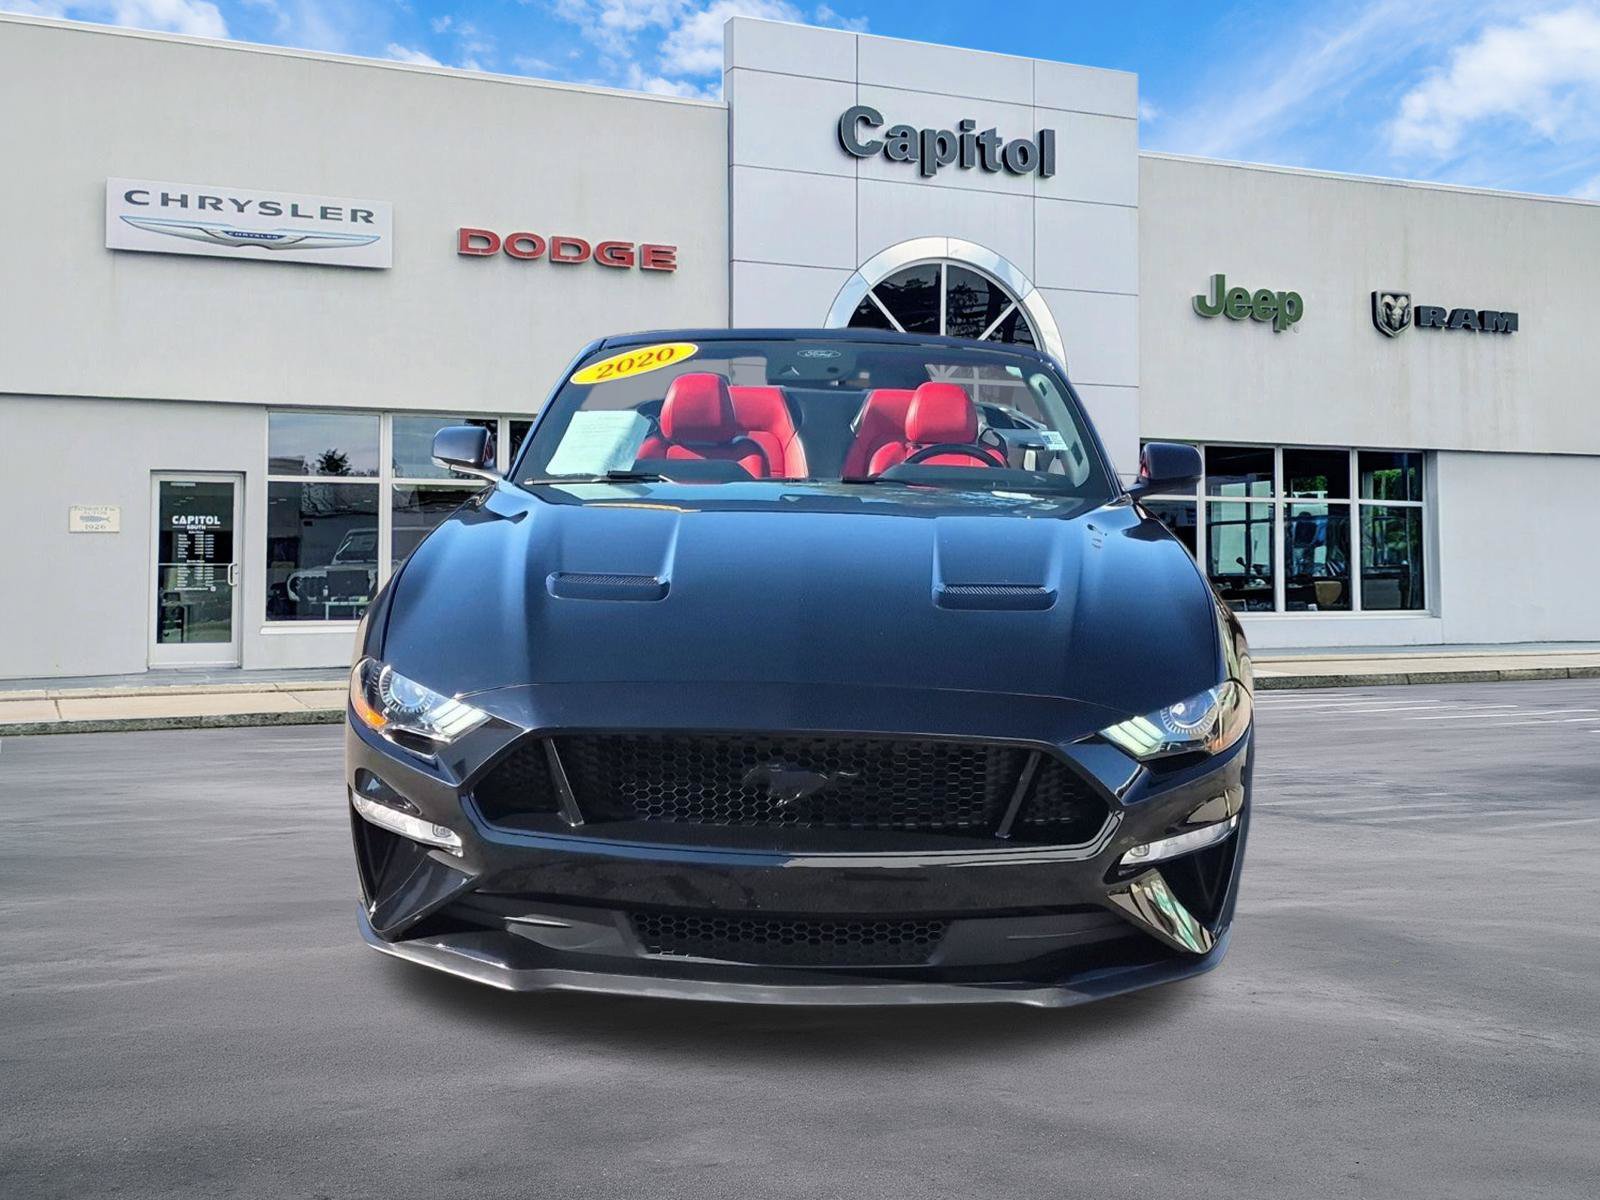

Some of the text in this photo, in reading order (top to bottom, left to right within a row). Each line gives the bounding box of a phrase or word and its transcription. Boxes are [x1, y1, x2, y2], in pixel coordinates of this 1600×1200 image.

[838, 105, 1056, 178] Capitol
[124, 190, 374, 224] CHRYSLER
[457, 227, 678, 272] DODGE
[1192, 273, 1304, 333] Jeep
[1414, 305, 1519, 334] RAM
[596, 347, 676, 381] 2020
[172, 515, 221, 525] CAPITOL
